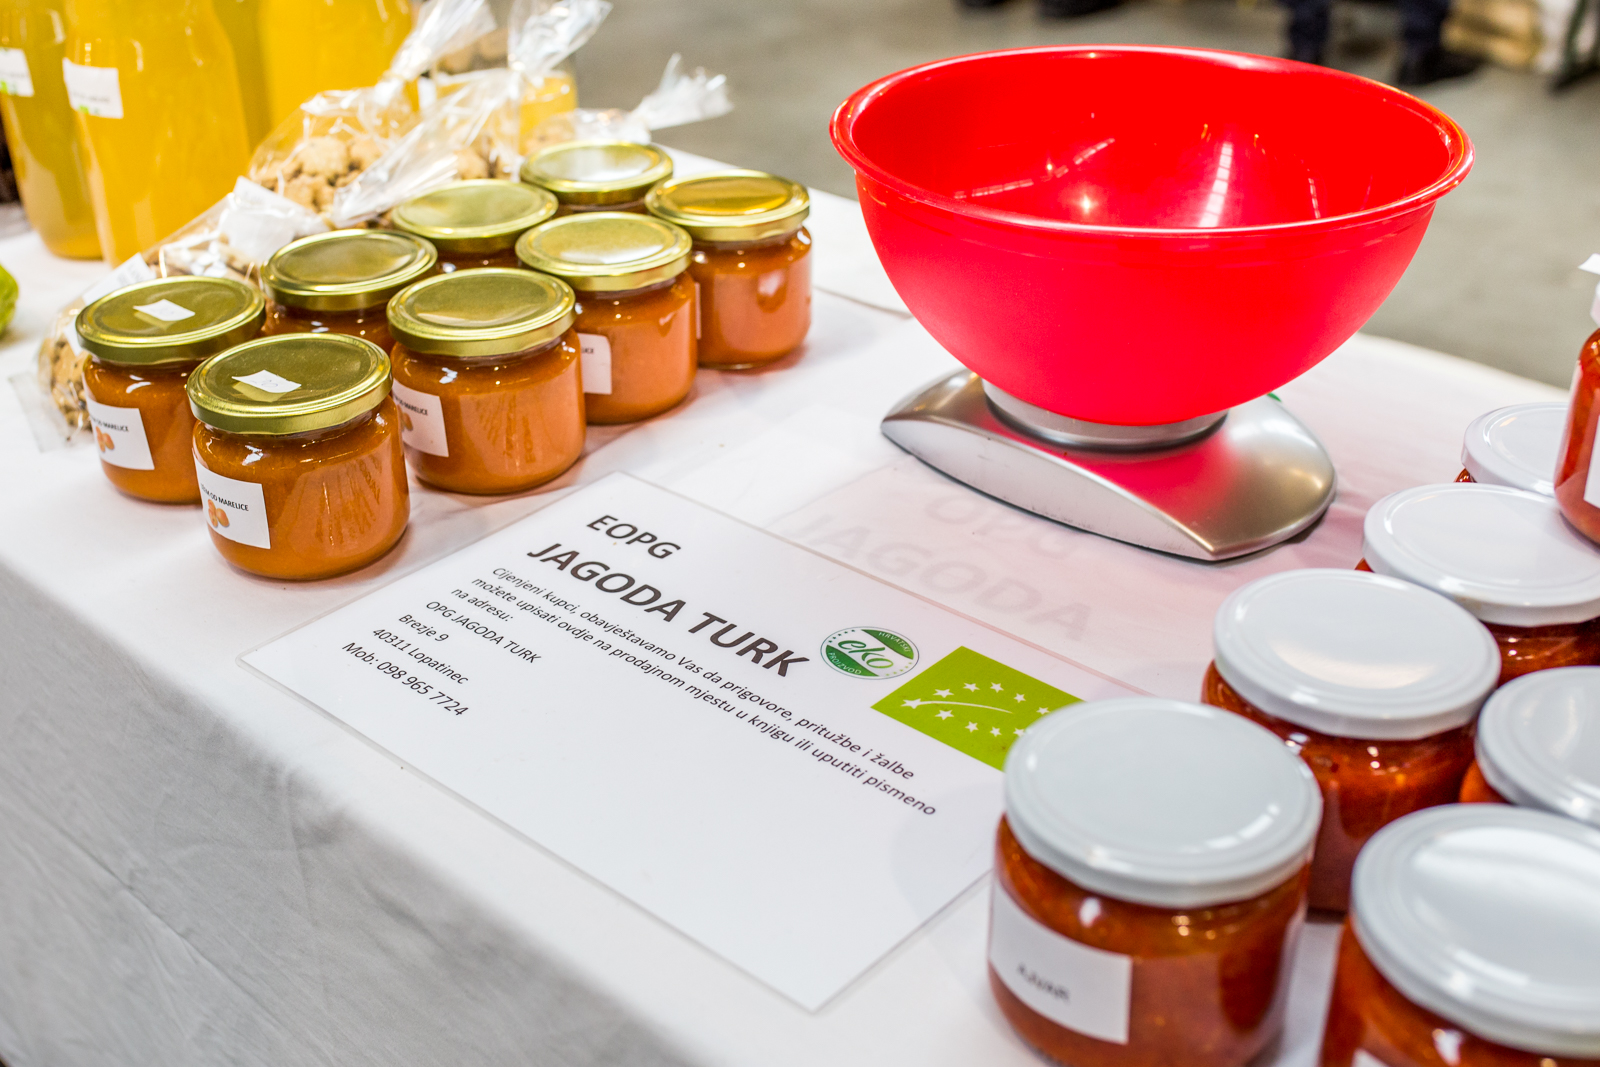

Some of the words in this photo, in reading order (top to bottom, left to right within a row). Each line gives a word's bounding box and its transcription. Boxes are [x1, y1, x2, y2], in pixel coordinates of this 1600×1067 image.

[218, 496, 249, 511] MARELICE
[587, 515, 681, 559] EOPG
[451, 587, 469, 600] na
[467, 597, 514, 622] adresu:
[528, 543, 686, 622] JAGODA
[688, 612, 810, 677] TURK
[399, 614, 436, 637] Brezje
[436, 633, 449, 642] 9
[426, 602, 456, 618] OPG
[452, 614, 504, 645] JAGODA
[503, 641, 541, 664] TURK
[878, 632, 911, 652] HRVATSKI
[373, 629, 411, 652] 40311
[408, 648, 468, 684] Lopatinec
[493, 568, 547, 595] Cijenjeni
[542, 590, 580, 614] kupci,
[580, 611, 676, 661] obavještavamo
[678, 656, 703, 674] Vas
[703, 671, 722, 684] da
[720, 680, 793, 721] prigovore,
[794, 718, 861, 753] pritužbe
[862, 749, 872, 757] i
[870, 751, 914, 780] žalbe
[828, 652, 861, 675] PROIZVOD
[838, 640, 894, 668] eko
[342, 642, 378, 665] Mob:
[377, 661, 406, 679] 098
[402, 676, 434, 694] 965
[430, 691, 468, 715] 7724
[472, 578, 516, 602] možete
[516, 598, 560, 624] upisati
[558, 621, 593, 642] ovdje
[593, 637, 612, 650] na
[609, 648, 685, 688] prodajnom
[685, 684, 736, 713] mjestu
[736, 710, 748, 719] u
[748, 715, 794, 744] knjigu
[794, 738, 814, 751] ili
[812, 749, 865, 778] uputiti
[862, 776, 936, 815] pismeno
